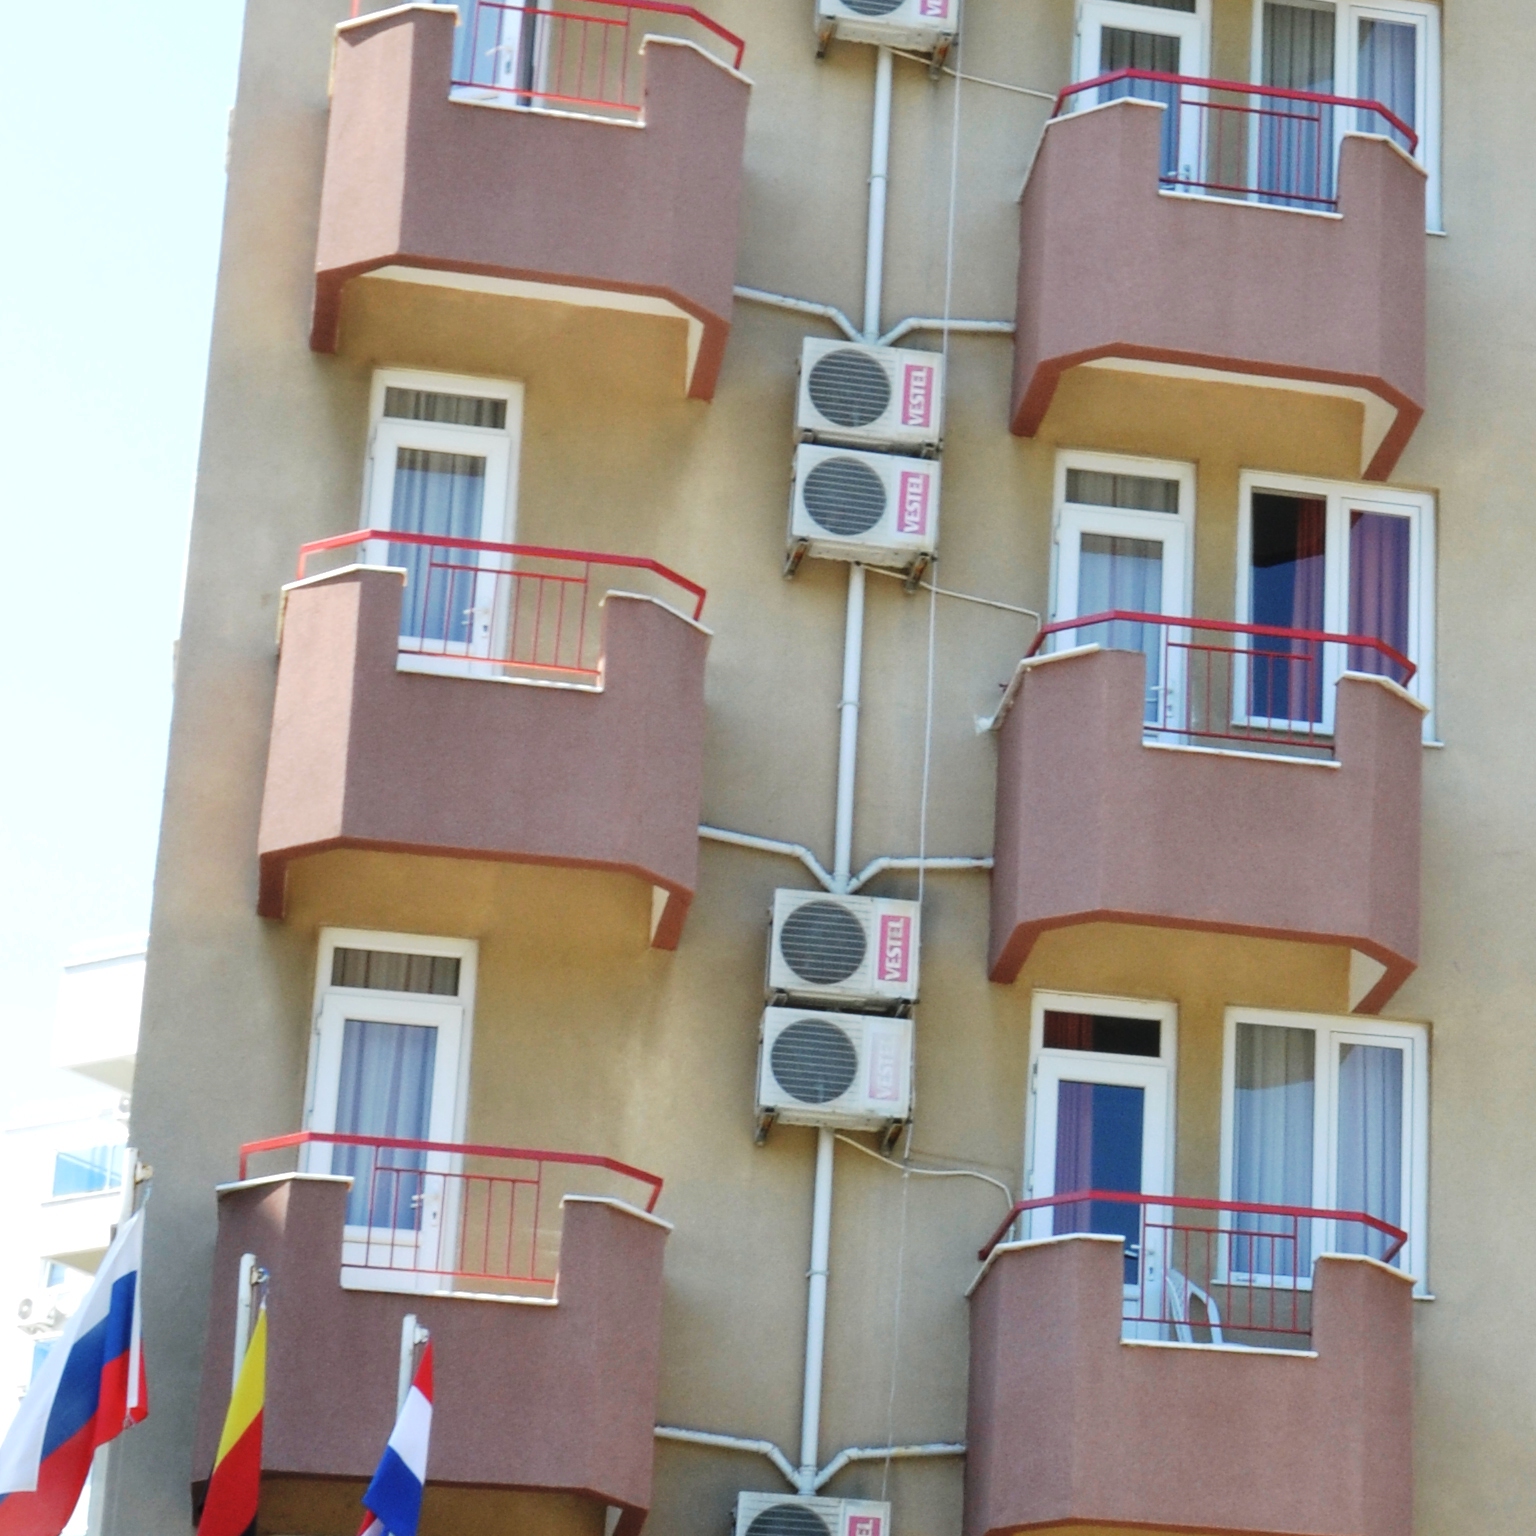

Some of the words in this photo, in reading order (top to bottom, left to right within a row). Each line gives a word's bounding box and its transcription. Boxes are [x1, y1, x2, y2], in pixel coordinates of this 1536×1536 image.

[906, 367, 928, 426] VESTEL
[902, 474, 924, 533] VESTEL
[884, 918, 905, 981] VESTEL
